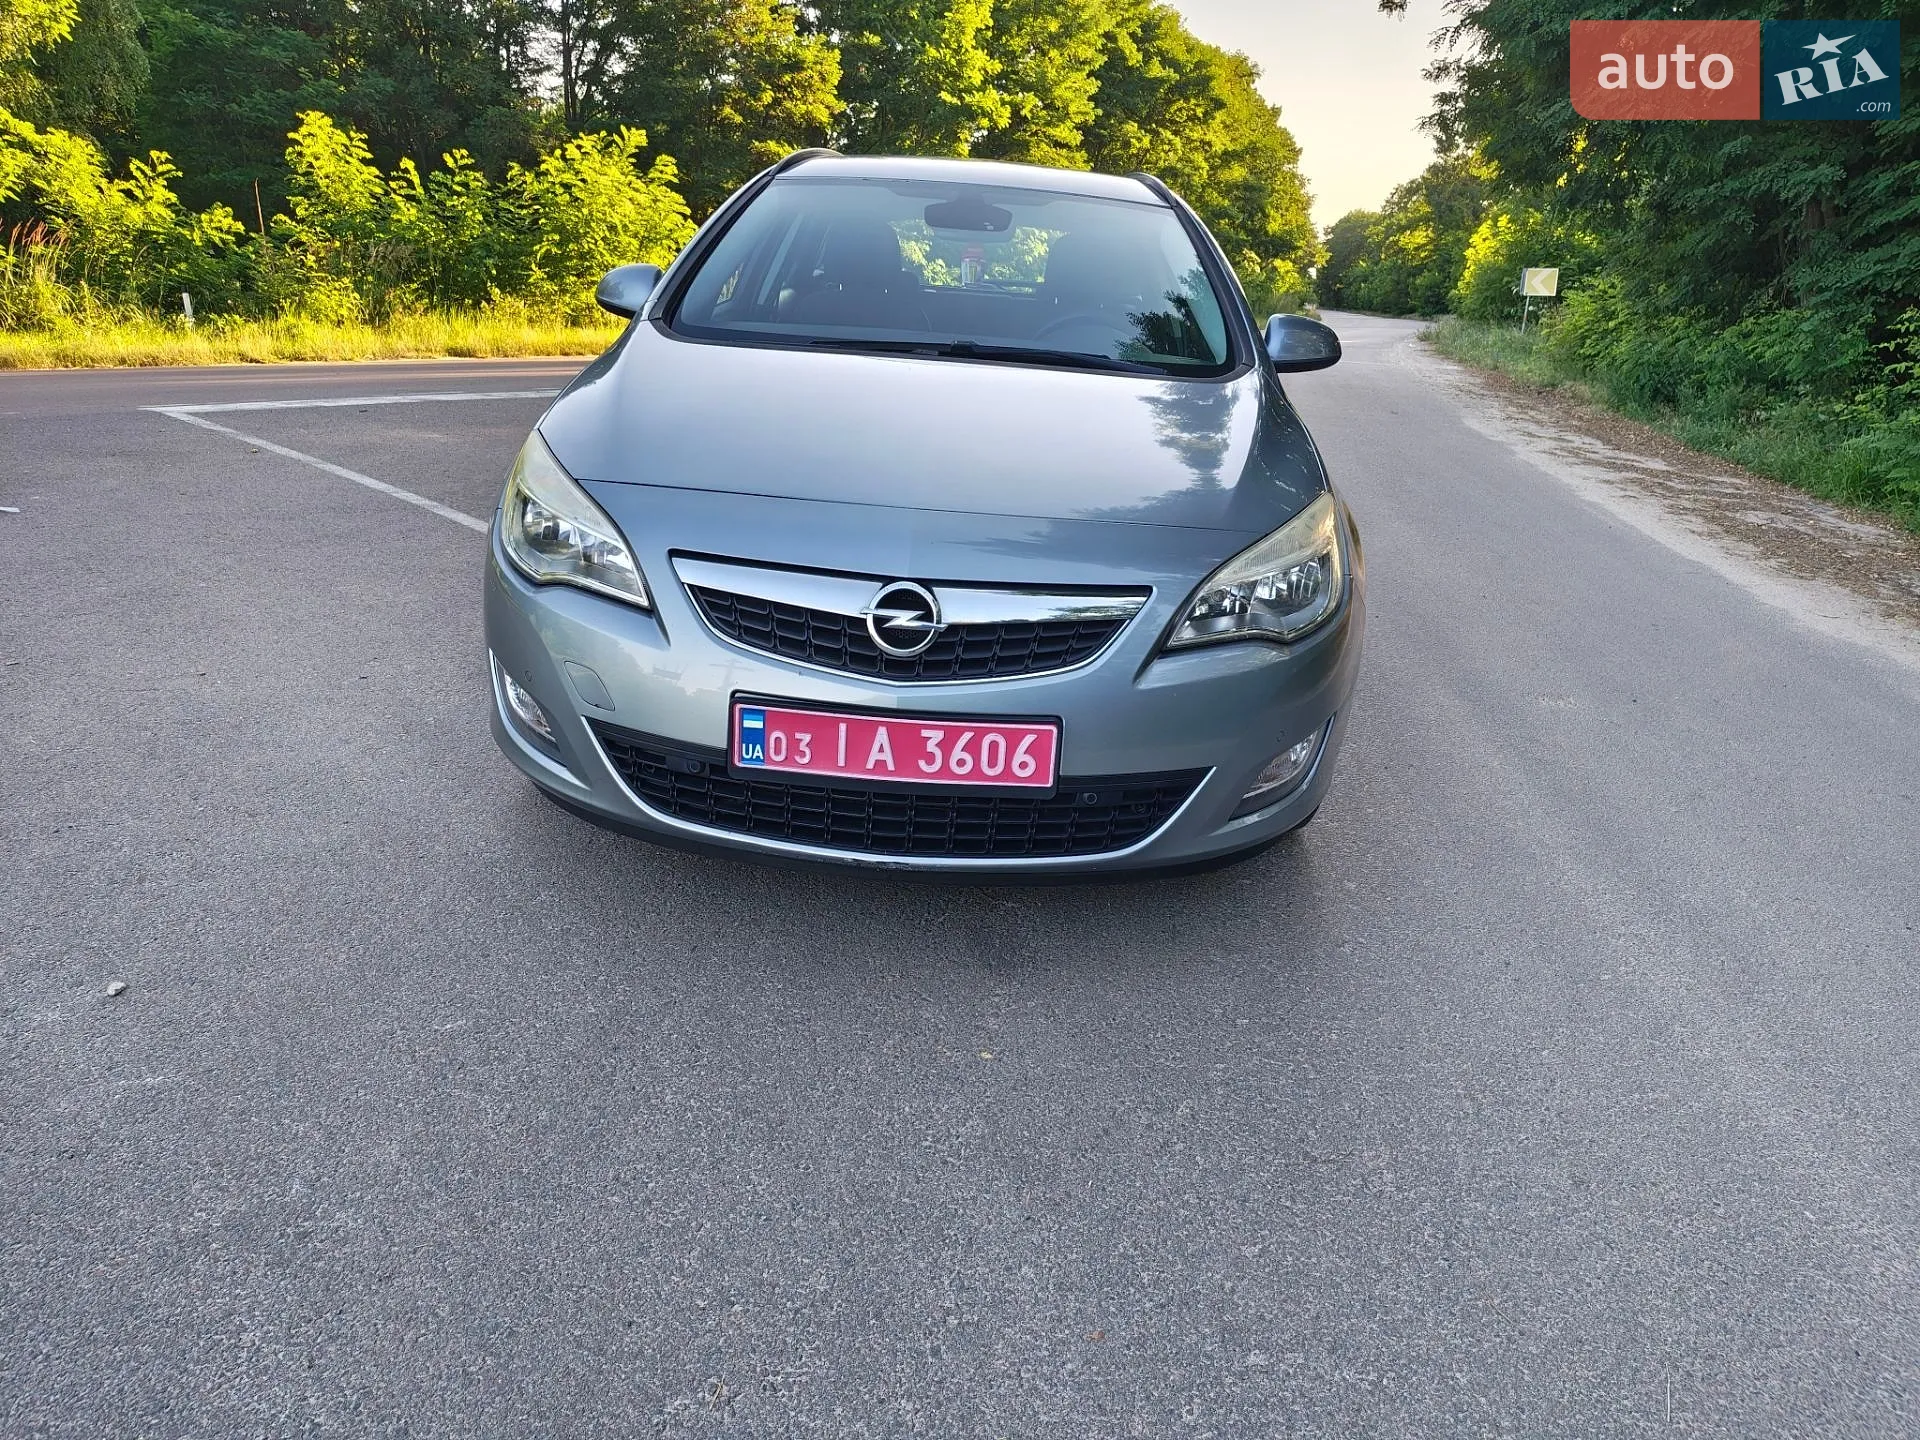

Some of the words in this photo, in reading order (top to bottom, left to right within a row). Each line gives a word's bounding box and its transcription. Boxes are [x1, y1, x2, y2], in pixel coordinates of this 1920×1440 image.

[741, 743, 764, 760] UA
[768, 730, 813, 765] 03
[917, 729, 1039, 778] 3606
